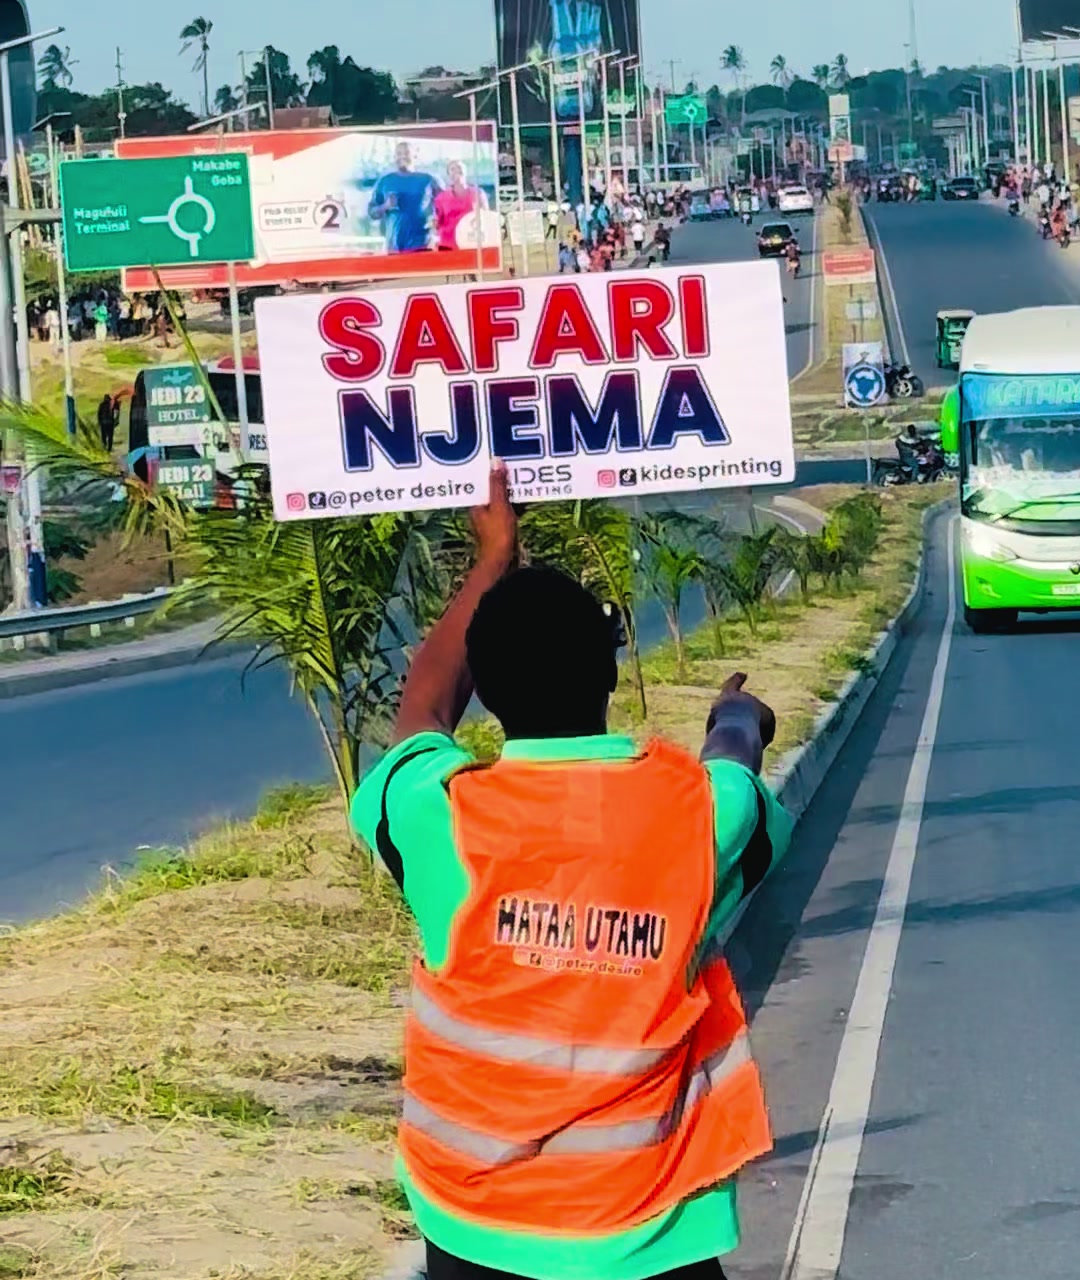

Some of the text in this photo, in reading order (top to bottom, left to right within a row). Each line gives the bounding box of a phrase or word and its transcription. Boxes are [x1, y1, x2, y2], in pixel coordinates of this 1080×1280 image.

[192, 159, 241, 172] Makabe
[211, 174, 243, 186] Goba
[73, 205, 127, 220] Magufuli
[319, 203, 340, 229] 2
[75, 219, 131, 234] Terminal
[319, 274, 710, 384] SAFARI
[151, 384, 206, 406] JEDI 23
[158, 409, 200, 422] HOTEL
[338, 365, 732, 473] NJEMA
[507, 464, 573, 486] IDES
[640, 458, 783, 482] kidesprinting
[328, 479, 476, 509] @peter desire
[507, 484, 573, 498] RINTING
